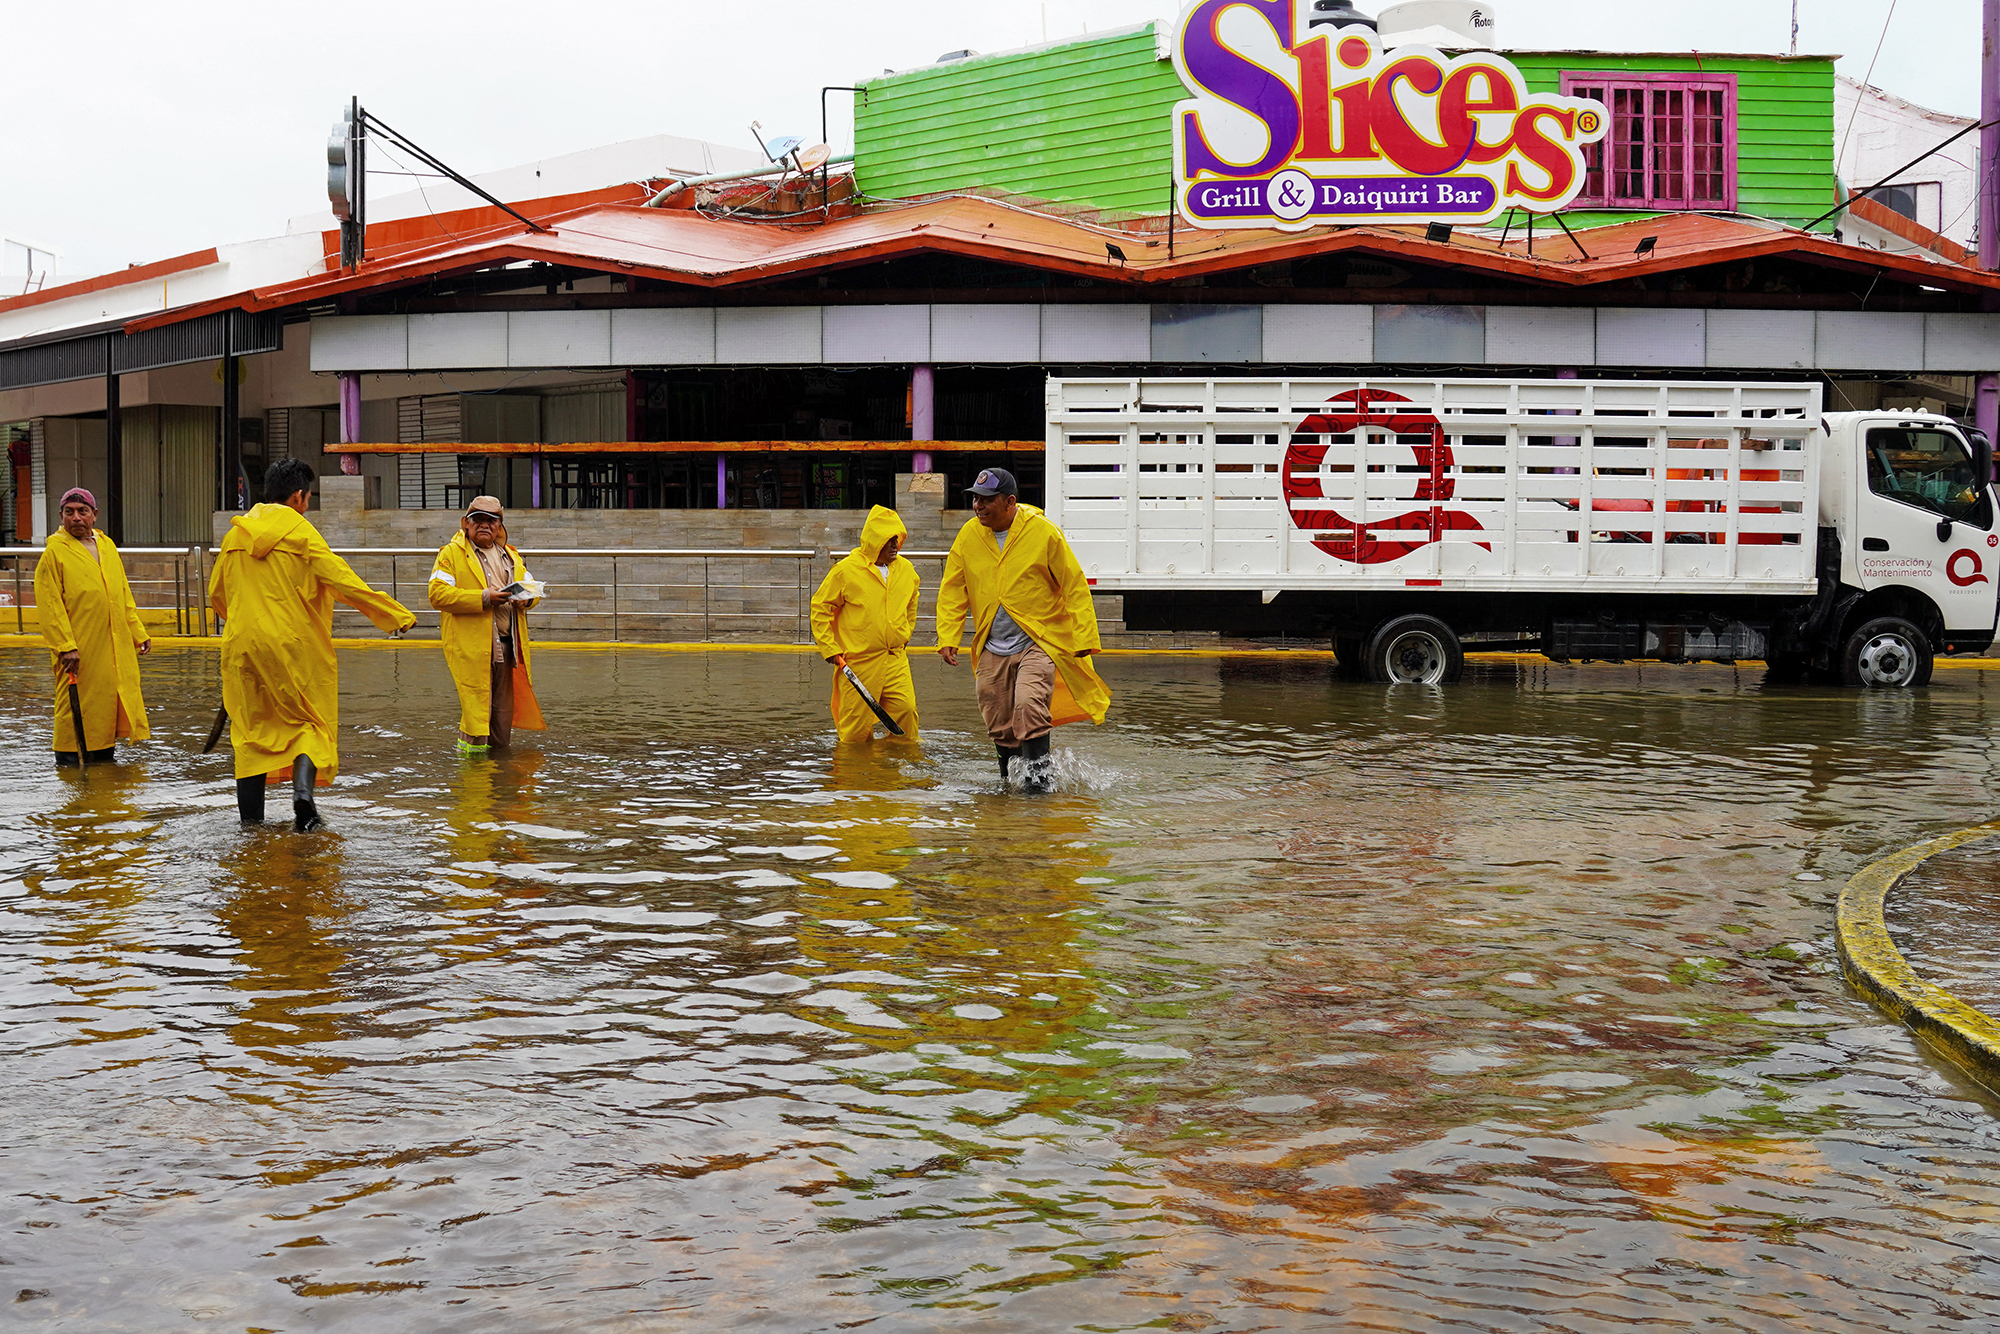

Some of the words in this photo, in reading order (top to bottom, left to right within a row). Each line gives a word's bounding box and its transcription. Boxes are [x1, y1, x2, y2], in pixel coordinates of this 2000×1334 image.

[1201, 186, 1261, 208] Grill
[1277, 179, 1306, 208] &
[1321, 184, 1429, 210] Daiquiri
[1436, 183, 1482, 205] Bar
[1988, 537, 1997, 545] 35
[1863, 557, 1925, 568] Conservación
[1926, 559, 1933, 569] y
[1863, 568, 1933, 577] Mantenimiento
